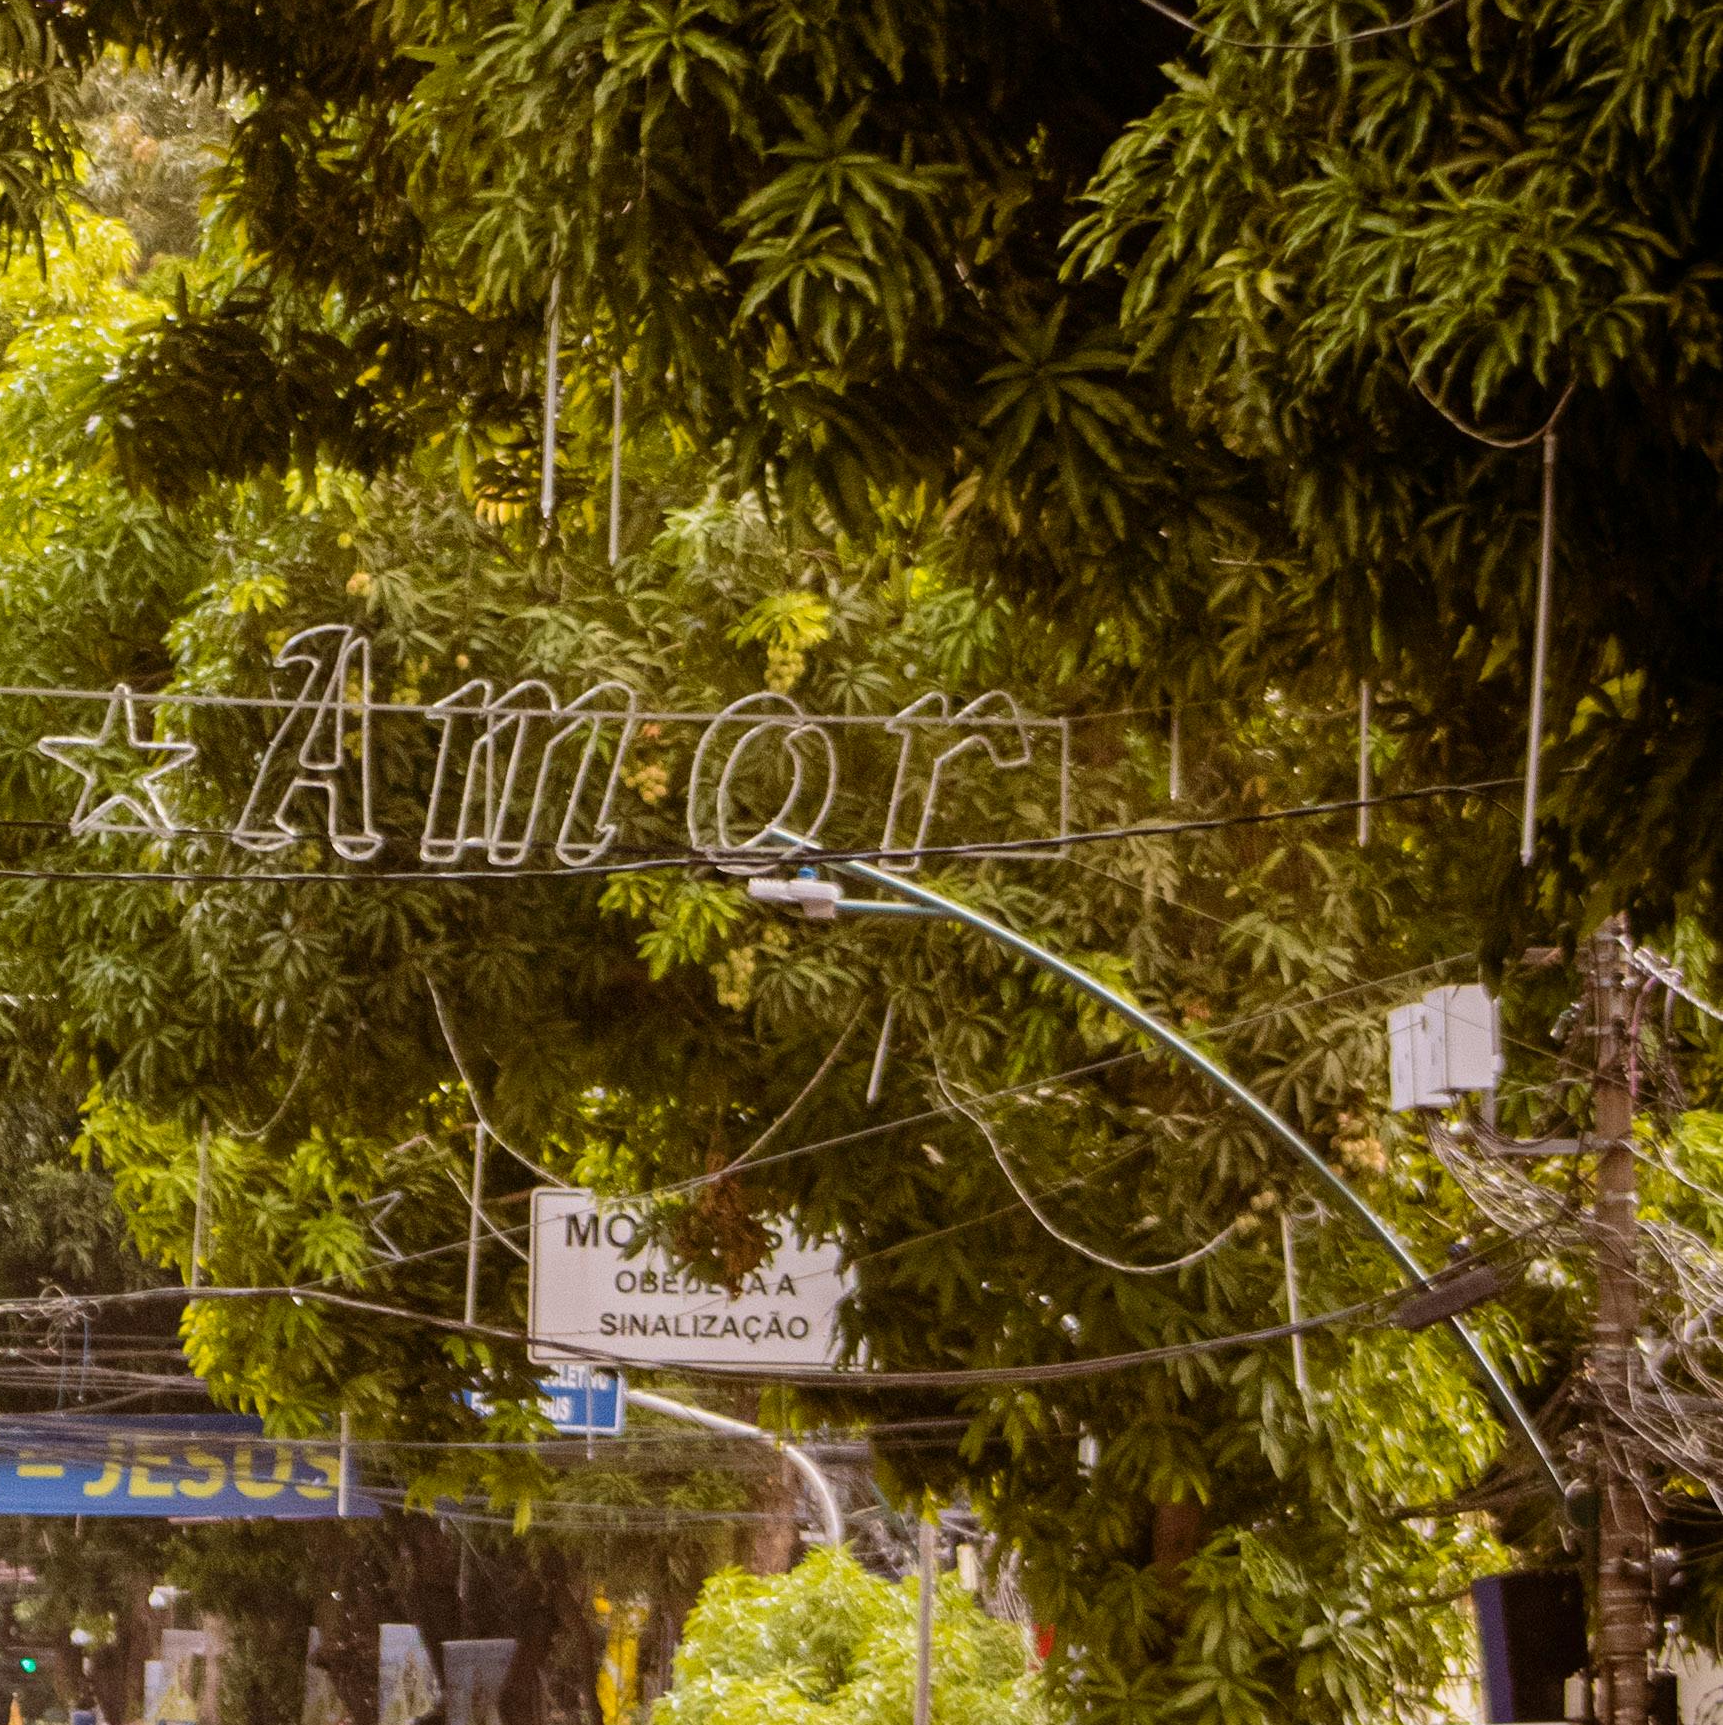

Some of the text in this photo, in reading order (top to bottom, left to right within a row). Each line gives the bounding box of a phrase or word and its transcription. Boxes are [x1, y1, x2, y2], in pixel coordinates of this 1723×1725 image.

[233, 624, 1032, 874] Amor
[614, 1270, 797, 1297] OBEDA A
[599, 1310, 810, 1344] SINALIZAÇÃO
[82, 1435, 342, 1499] JESUS
